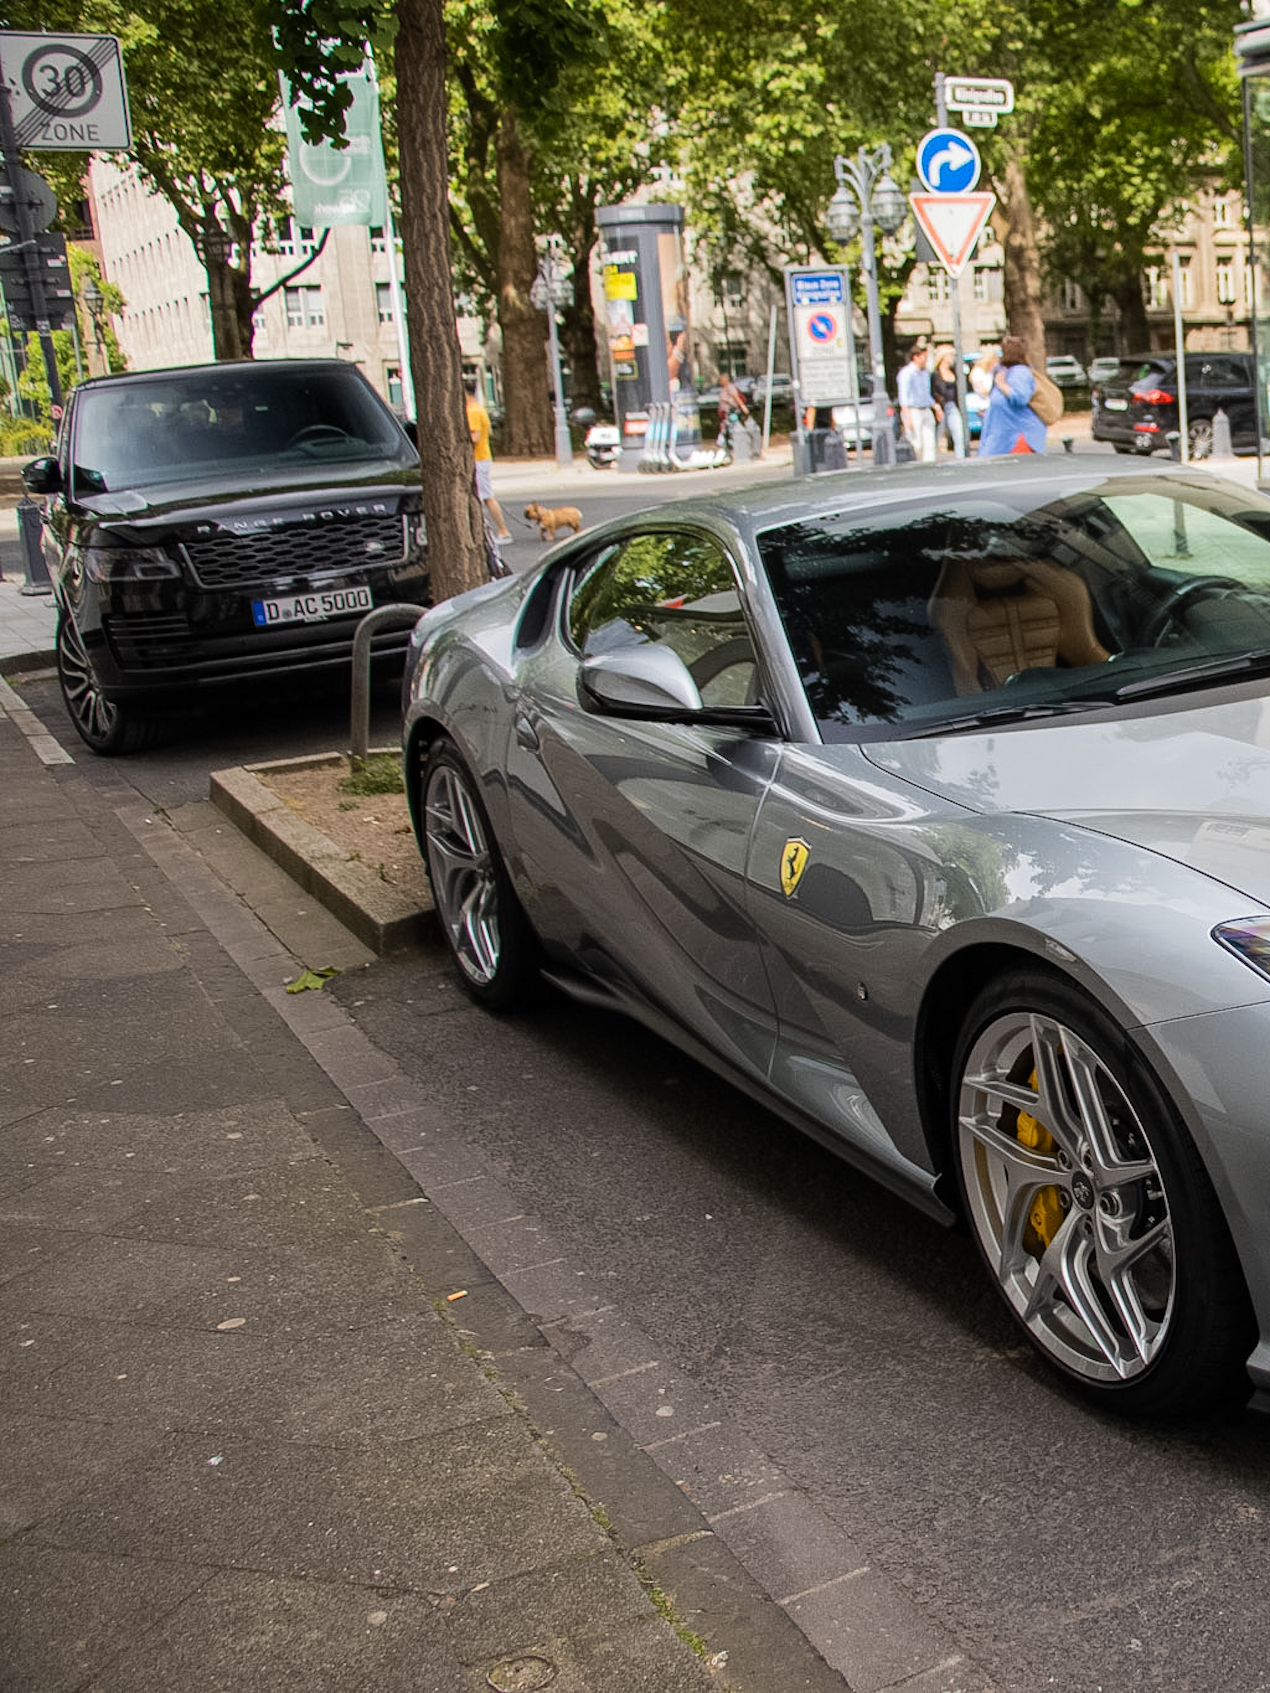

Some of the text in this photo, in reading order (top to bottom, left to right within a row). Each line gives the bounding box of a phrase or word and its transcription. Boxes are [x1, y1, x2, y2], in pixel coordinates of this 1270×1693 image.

[39, 64, 86, 98] 30
[40, 122, 100, 142] ZONE
[197, 503, 387, 534] RANGE ROVER
[266, 590, 370, 621] D AC 5000
